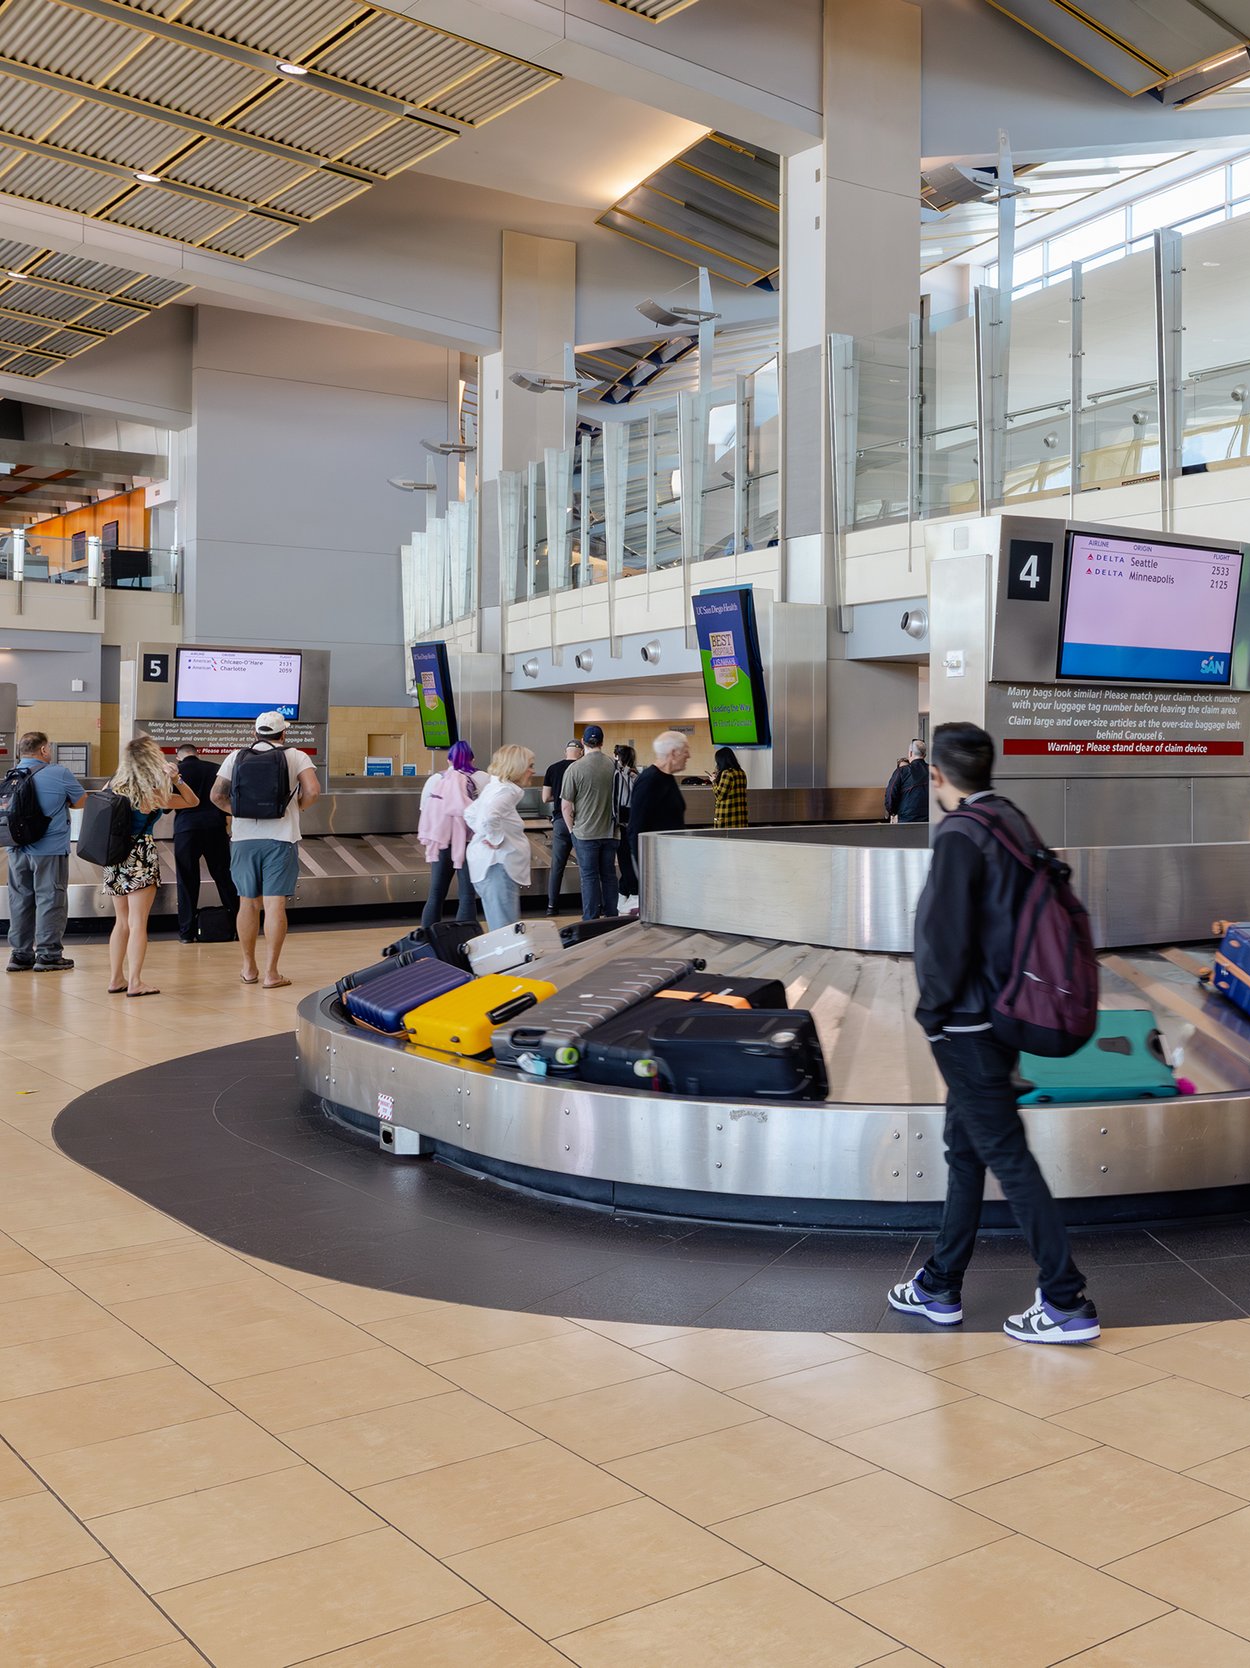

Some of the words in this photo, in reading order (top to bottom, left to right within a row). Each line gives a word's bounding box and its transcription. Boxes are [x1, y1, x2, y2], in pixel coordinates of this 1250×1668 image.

[1088, 540, 1109, 548] AIRLINE
[1133, 544, 1153, 552] ORIGIN
[1020, 555, 1040, 589] 4
[1096, 554, 1125, 563] DELTA
[1130, 557, 1158, 569] Seattle
[1211, 566, 1230, 577] 2533
[1095, 568, 1123, 577] DELTA
[1129, 571, 1175, 584] Minneapolis
[1210, 579, 1228, 590] 2125
[711, 634, 731, 647] BEST
[150, 660, 161, 677] 5
[1200, 659, 1225, 675] SAN
[1007, 687, 1031, 699] Many
[1033, 687, 1052, 699] bags
[1054, 688, 1072, 698] look
[1073, 689, 1102, 699] similar!
[1104, 690, 1129, 700] Please
[1130, 691, 1153, 701] match
[1154, 694, 1171, 703] your
[1173, 692, 1191, 702] claim
[1193, 694, 1213, 703] check
[1214, 694, 1241, 704] number
[1012, 699, 1031, 709] with
[1033, 701, 1052, 712] your
[1053, 700, 1086, 713] luggage
[1088, 703, 1101, 713] tag
[1103, 703, 1133, 712] number
[1134, 702, 1159, 713] before
[1160, 703, 1186, 715] leaving
[1188, 705, 1200, 714] the
[1201, 705, 1219, 714] claim
[1221, 707, 1238, 715] area.
[1008, 716, 1031, 726] Claim
[1033, 716, 1054, 728] large
[1056, 717, 1072, 726] and
[1073, 718, 1108, 727] over-size
[1109, 718, 1137, 728] articles
[1139, 720, 1147, 728] at
[1148, 719, 1160, 728] the
[1162, 721, 1194, 729] over-size
[1195, 720, 1225, 731] baggage
[1227, 721, 1241, 729] belt
[1096, 730, 1123, 740] behind
[1125, 731, 1157, 740] Carousel
[1158, 732, 1165, 740] 6.
[1047, 742, 1085, 754] Warning:
[1087, 743, 1111, 752] Please
[1112, 743, 1134, 752] stand
[1135, 743, 1154, 752] clear
[1155, 743, 1164, 752] of
[1164, 743, 1183, 753] claim
[1184, 744, 1208, 753] device
